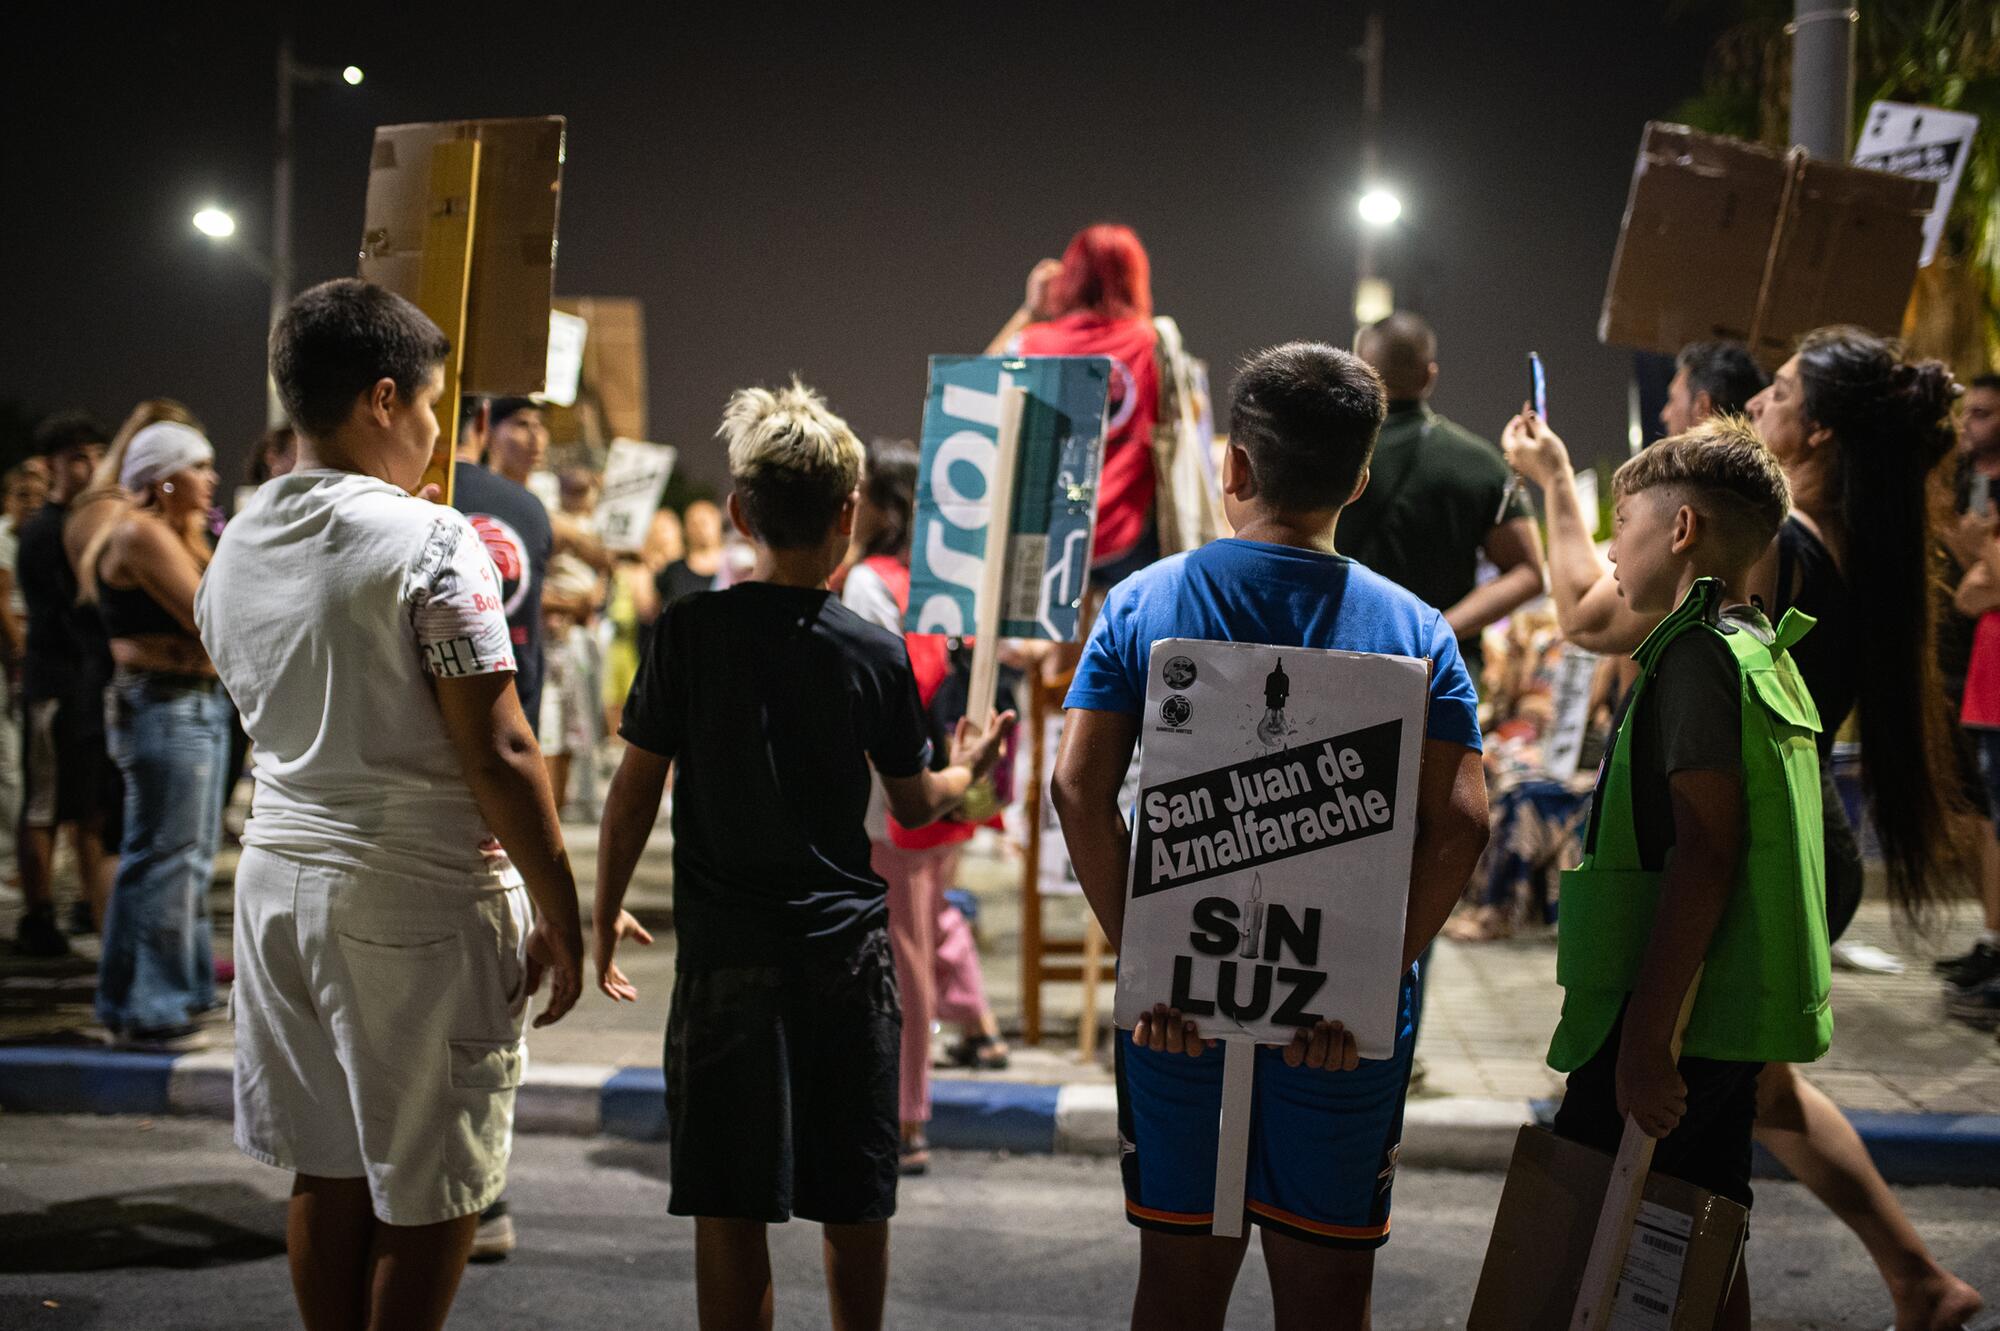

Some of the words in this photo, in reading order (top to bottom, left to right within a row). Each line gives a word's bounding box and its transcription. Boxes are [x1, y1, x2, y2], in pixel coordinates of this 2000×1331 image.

[1145, 784, 1216, 833] San
[1223, 760, 1312, 814] Juan
[1316, 742, 1365, 787] de
[1151, 786, 1391, 885] Aznalfarache
[1189, 896, 1322, 965] SIN
[1171, 955, 1327, 1028] LUZ
